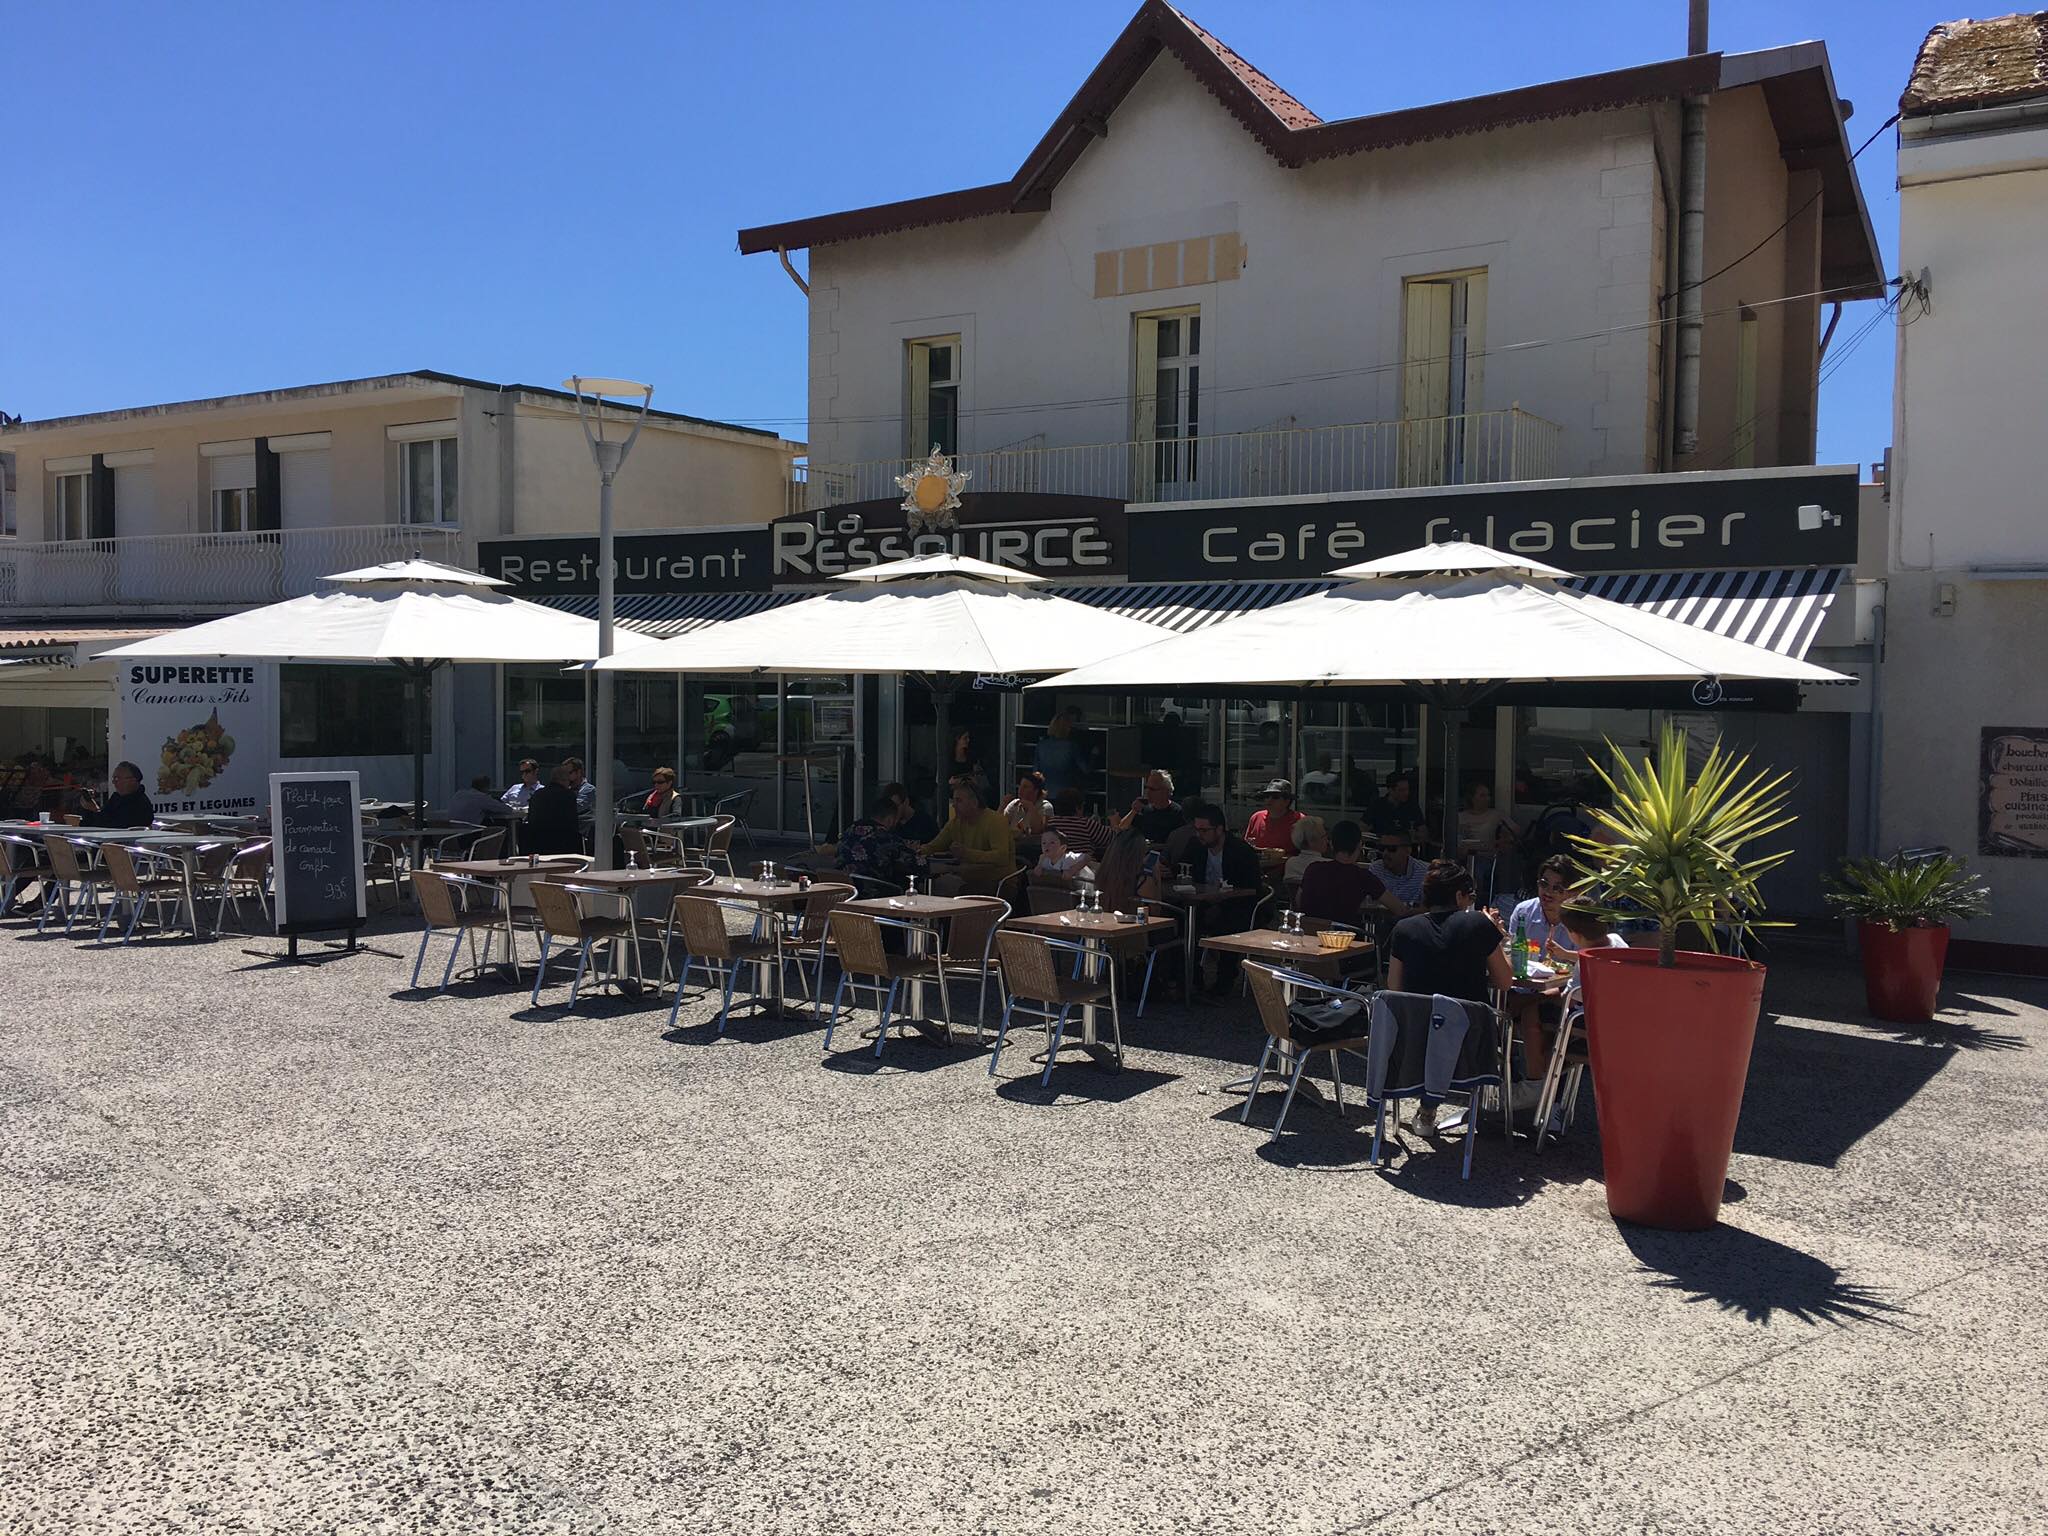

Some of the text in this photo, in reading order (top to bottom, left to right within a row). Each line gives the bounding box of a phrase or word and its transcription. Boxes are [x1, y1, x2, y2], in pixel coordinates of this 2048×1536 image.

[817, 511, 863, 535] La
[1203, 522, 1365, 563] Café
[131, 666, 254, 684] SUPERETTE
[131, 687, 205, 704] Canovas
[218, 687, 251, 703] Fils
[151, 797, 255, 813] UITS ET LEGUMES
